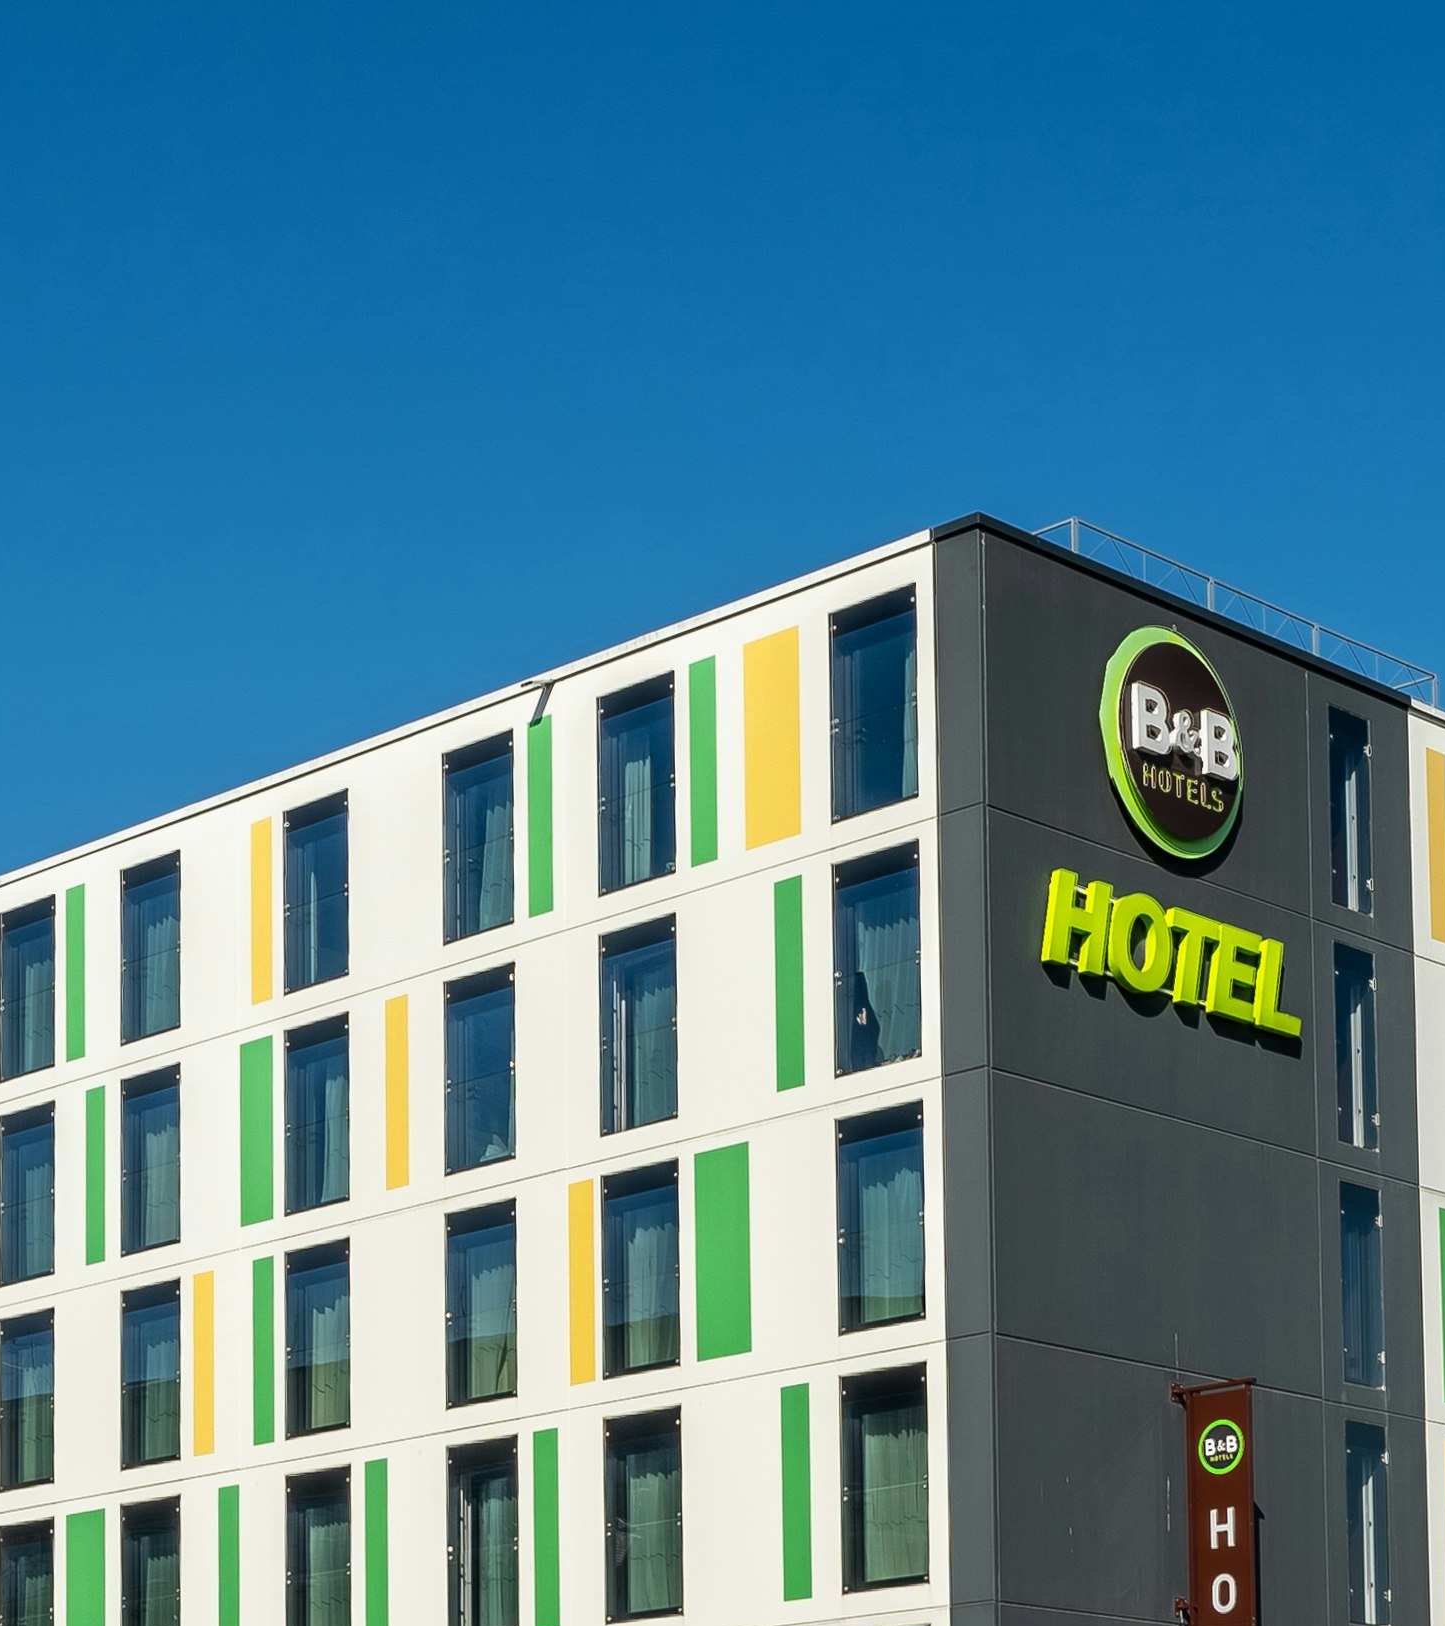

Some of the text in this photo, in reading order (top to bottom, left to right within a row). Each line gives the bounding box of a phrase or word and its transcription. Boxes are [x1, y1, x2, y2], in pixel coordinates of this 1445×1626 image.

[1131, 680, 1240, 781] B&B
[1142, 762, 1225, 813] HOTELS
[1041, 867, 1303, 1037] HOTEL
[1205, 1435, 1238, 1457] B&B
